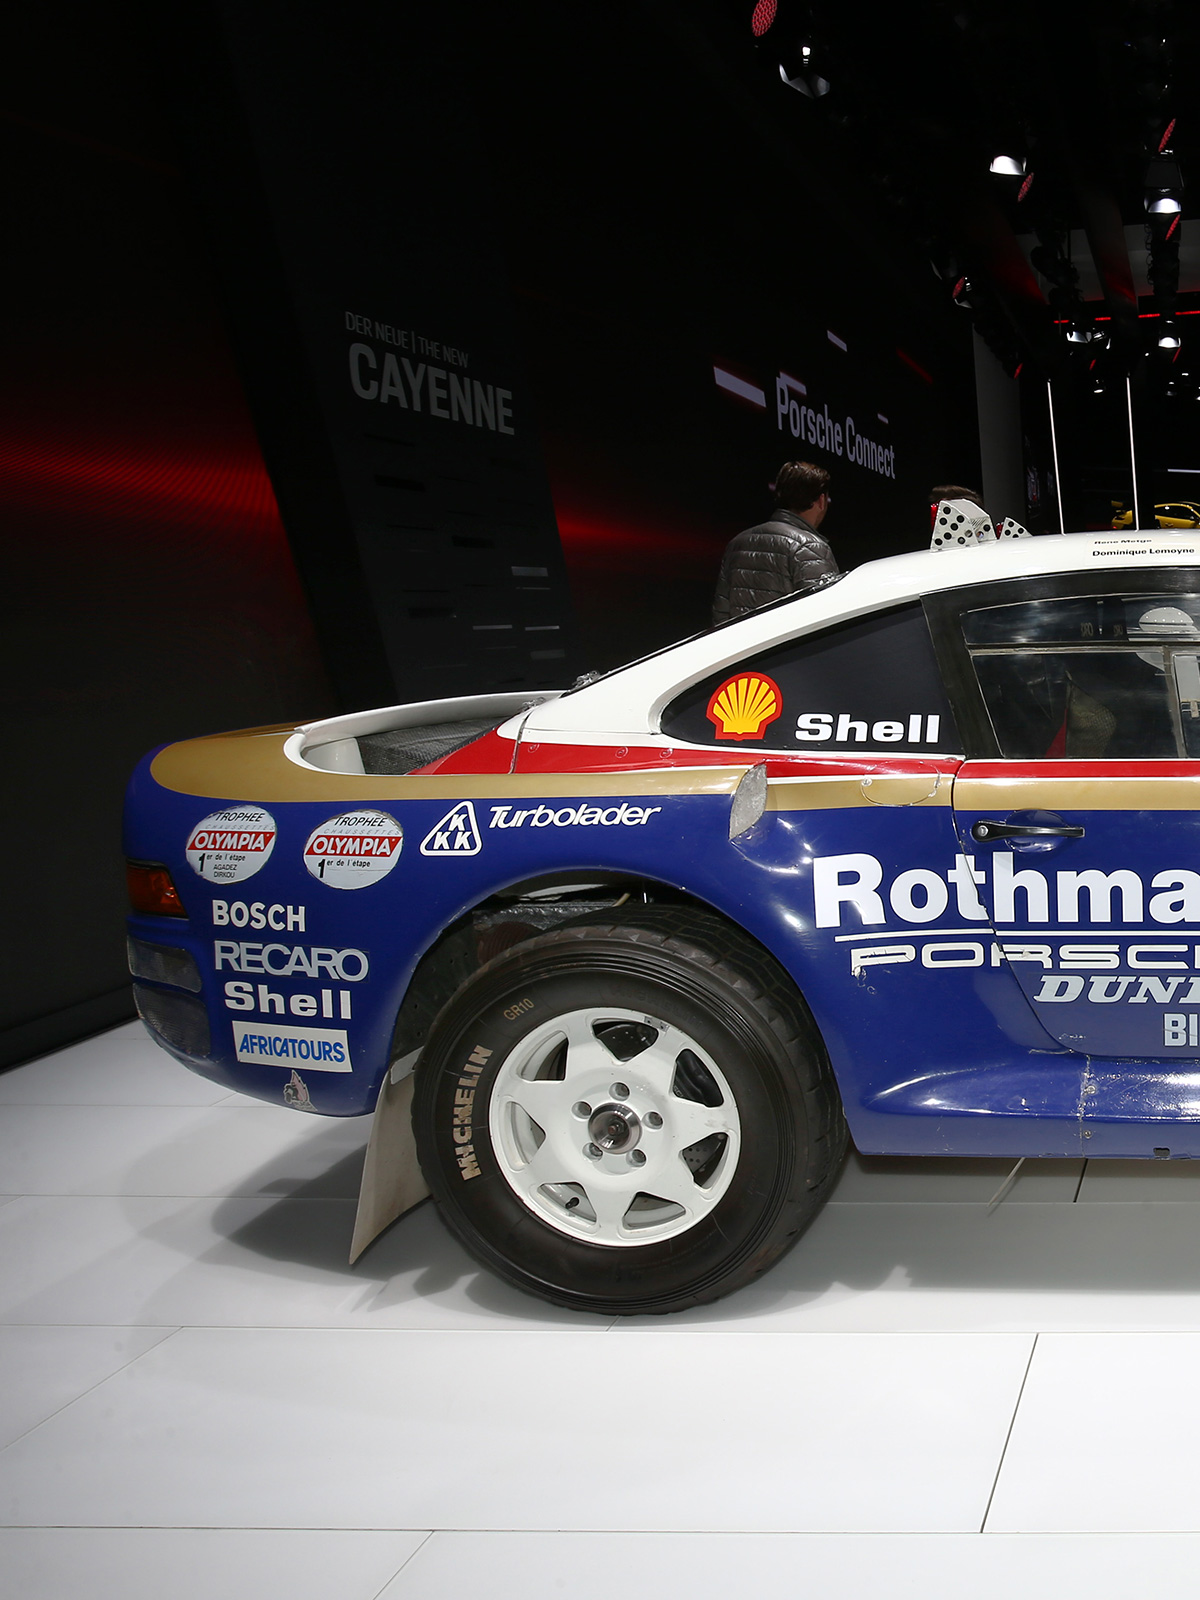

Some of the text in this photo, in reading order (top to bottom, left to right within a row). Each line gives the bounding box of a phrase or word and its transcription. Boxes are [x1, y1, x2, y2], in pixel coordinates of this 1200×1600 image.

[345, 311, 469, 368] DER NEUE THE NEW
[349, 342, 515, 435] CAYENNE
[776, 376, 896, 480] Porsche Connect
[1092, 549, 1147, 557] Dominique
[795, 713, 940, 743] Shell
[216, 812, 265, 822] TROPHEE
[334, 816, 387, 827] TROPHEE
[488, 803, 662, 829] Turbolader
[194, 832, 266, 850] OLYMPIA
[313, 837, 391, 855] OLYMPIA
[212, 899, 306, 932] BOSCH
[214, 940, 369, 982] RECARO
[224, 981, 352, 1019] Shell
[503, 998, 535, 1021] GR10
[239, 1033, 346, 1063] AFRICATOURS
[453, 1045, 493, 1181] MICHELIN
